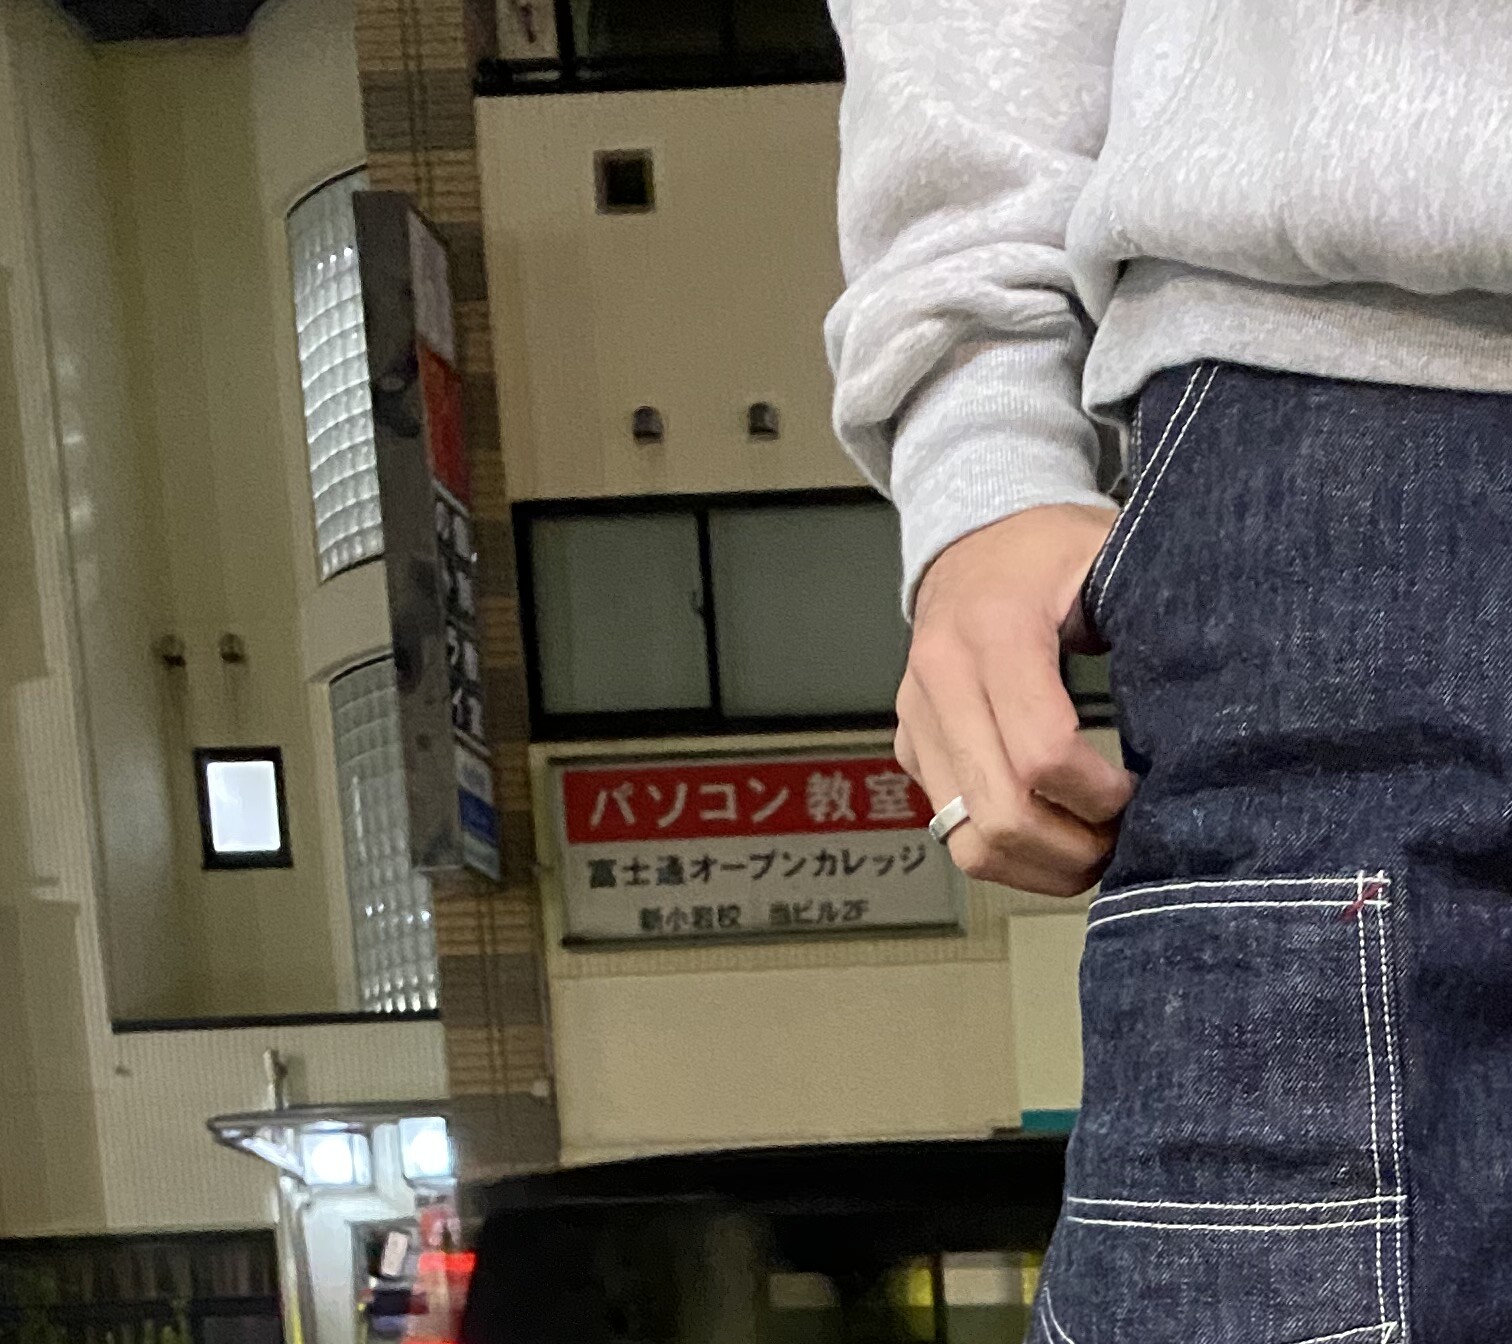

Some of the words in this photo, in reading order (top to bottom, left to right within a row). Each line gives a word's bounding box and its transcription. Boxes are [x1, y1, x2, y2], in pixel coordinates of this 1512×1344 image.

[589, 770, 918, 829] パソコン教室
[588, 844, 927, 889] 富士通オープンカレッジ
